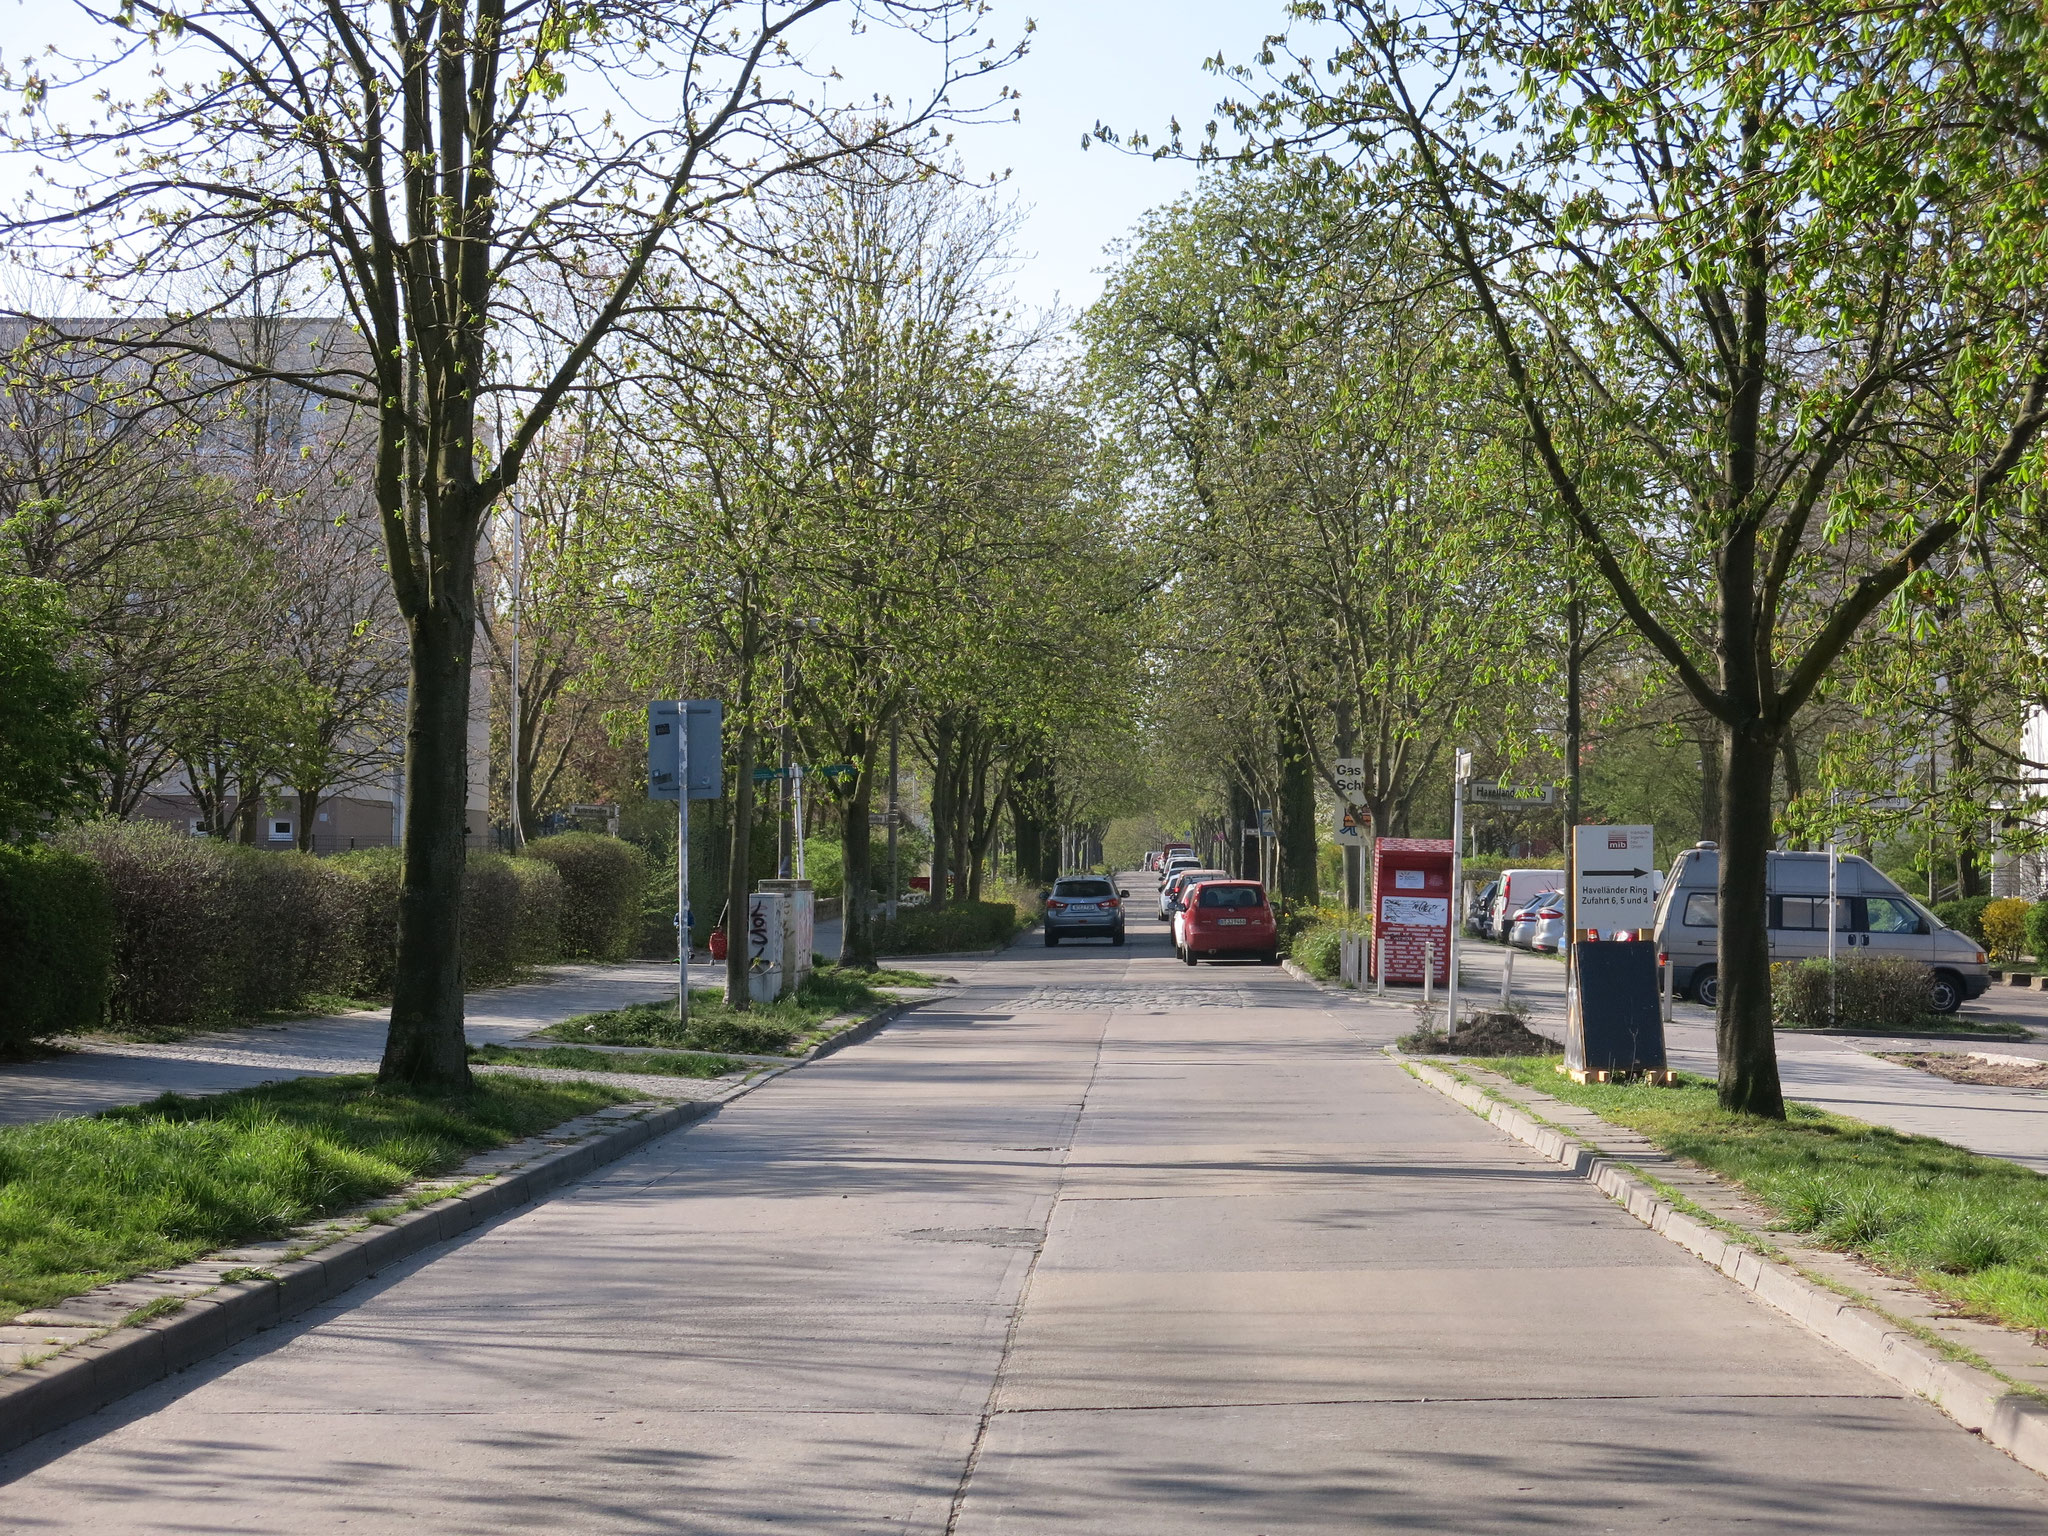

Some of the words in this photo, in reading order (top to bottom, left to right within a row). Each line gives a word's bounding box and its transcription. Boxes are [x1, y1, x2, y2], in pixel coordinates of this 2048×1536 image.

[1582, 886, 1627, 894] Havelländer
[1630, 886, 1648, 895] Ring
[1612, 897, 1618, 905] 6,
